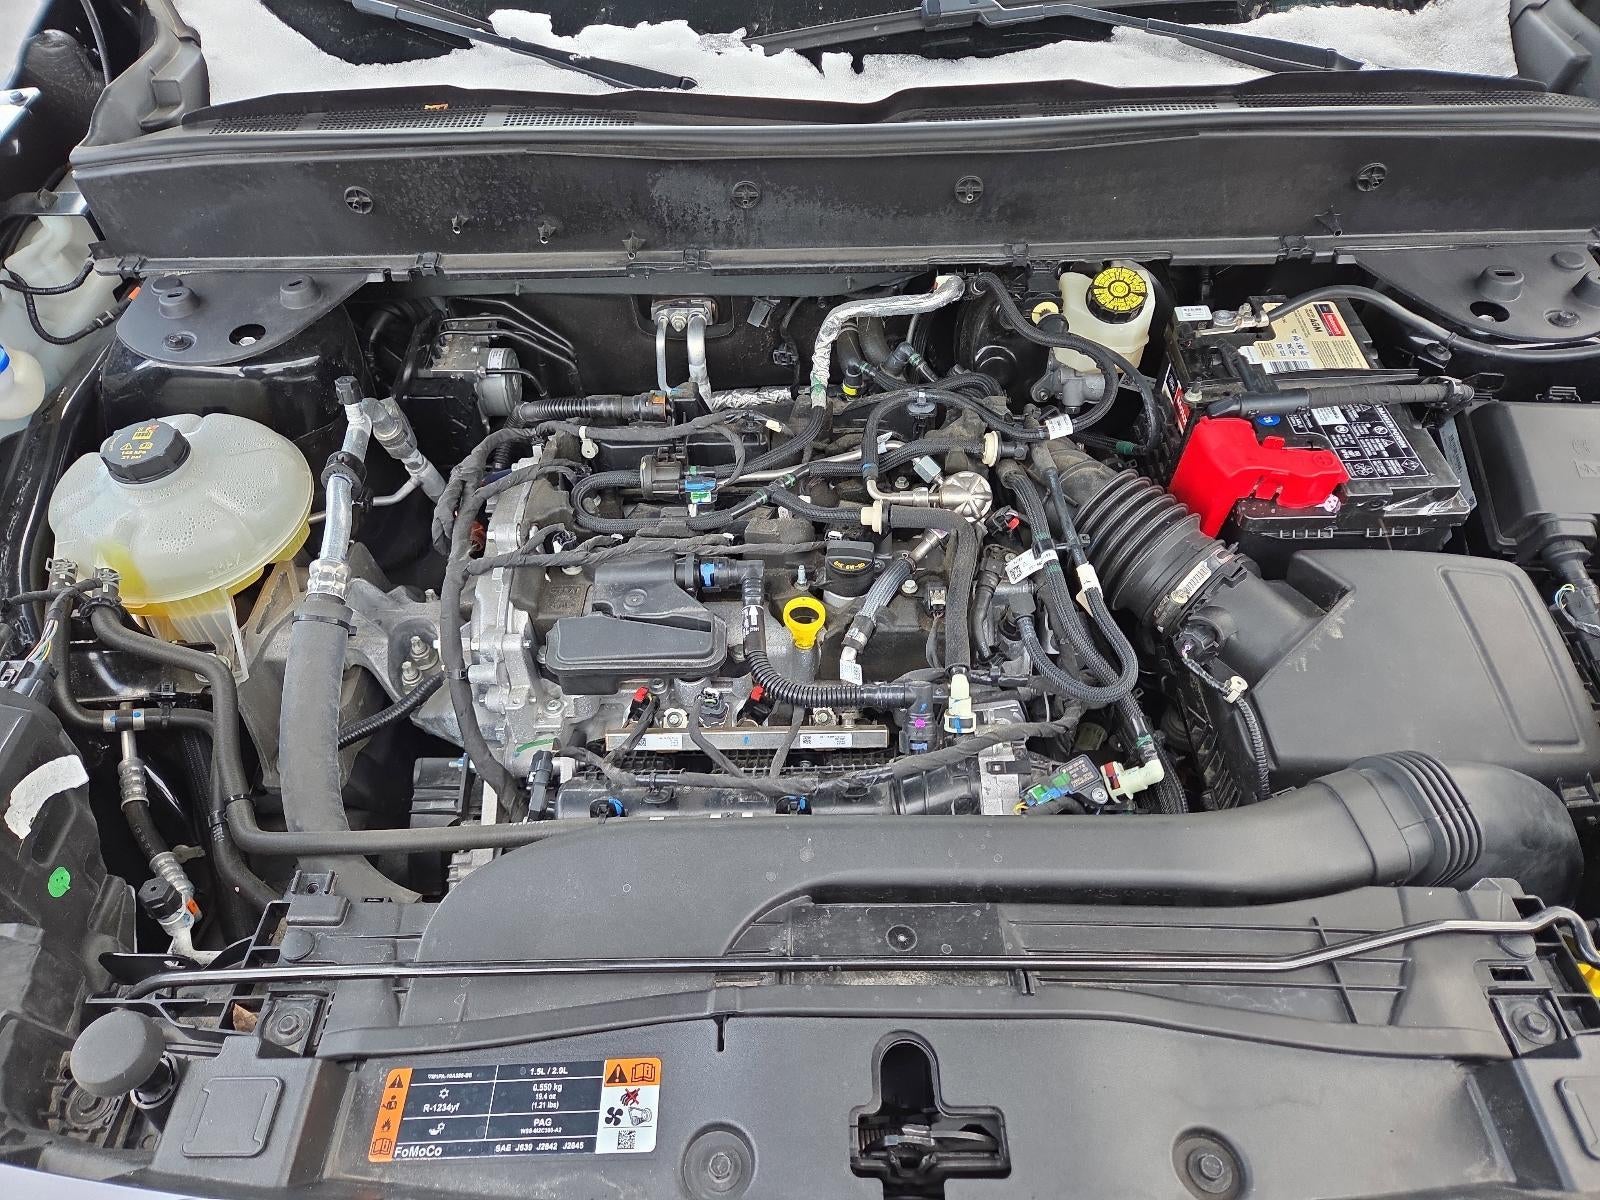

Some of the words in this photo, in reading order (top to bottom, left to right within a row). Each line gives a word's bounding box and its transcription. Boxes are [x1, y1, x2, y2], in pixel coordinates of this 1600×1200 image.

[1310, 318, 1323, 333] AGM
[529, 1067, 546, 1076] 1.5L
[551, 1066, 569, 1075] 2.0L
[532, 1083, 552, 1092] 0.550
[553, 1083, 563, 1093] kg
[422, 1102, 460, 1113] R-1234yf
[531, 1101, 546, 1110] (1.21
[547, 1100, 559, 1109] lbs)
[533, 1117, 552, 1127] PAG
[394, 1144, 442, 1158] FoMoCo
[495, 1143, 512, 1153] SAE
[515, 1142, 533, 1152] J639
